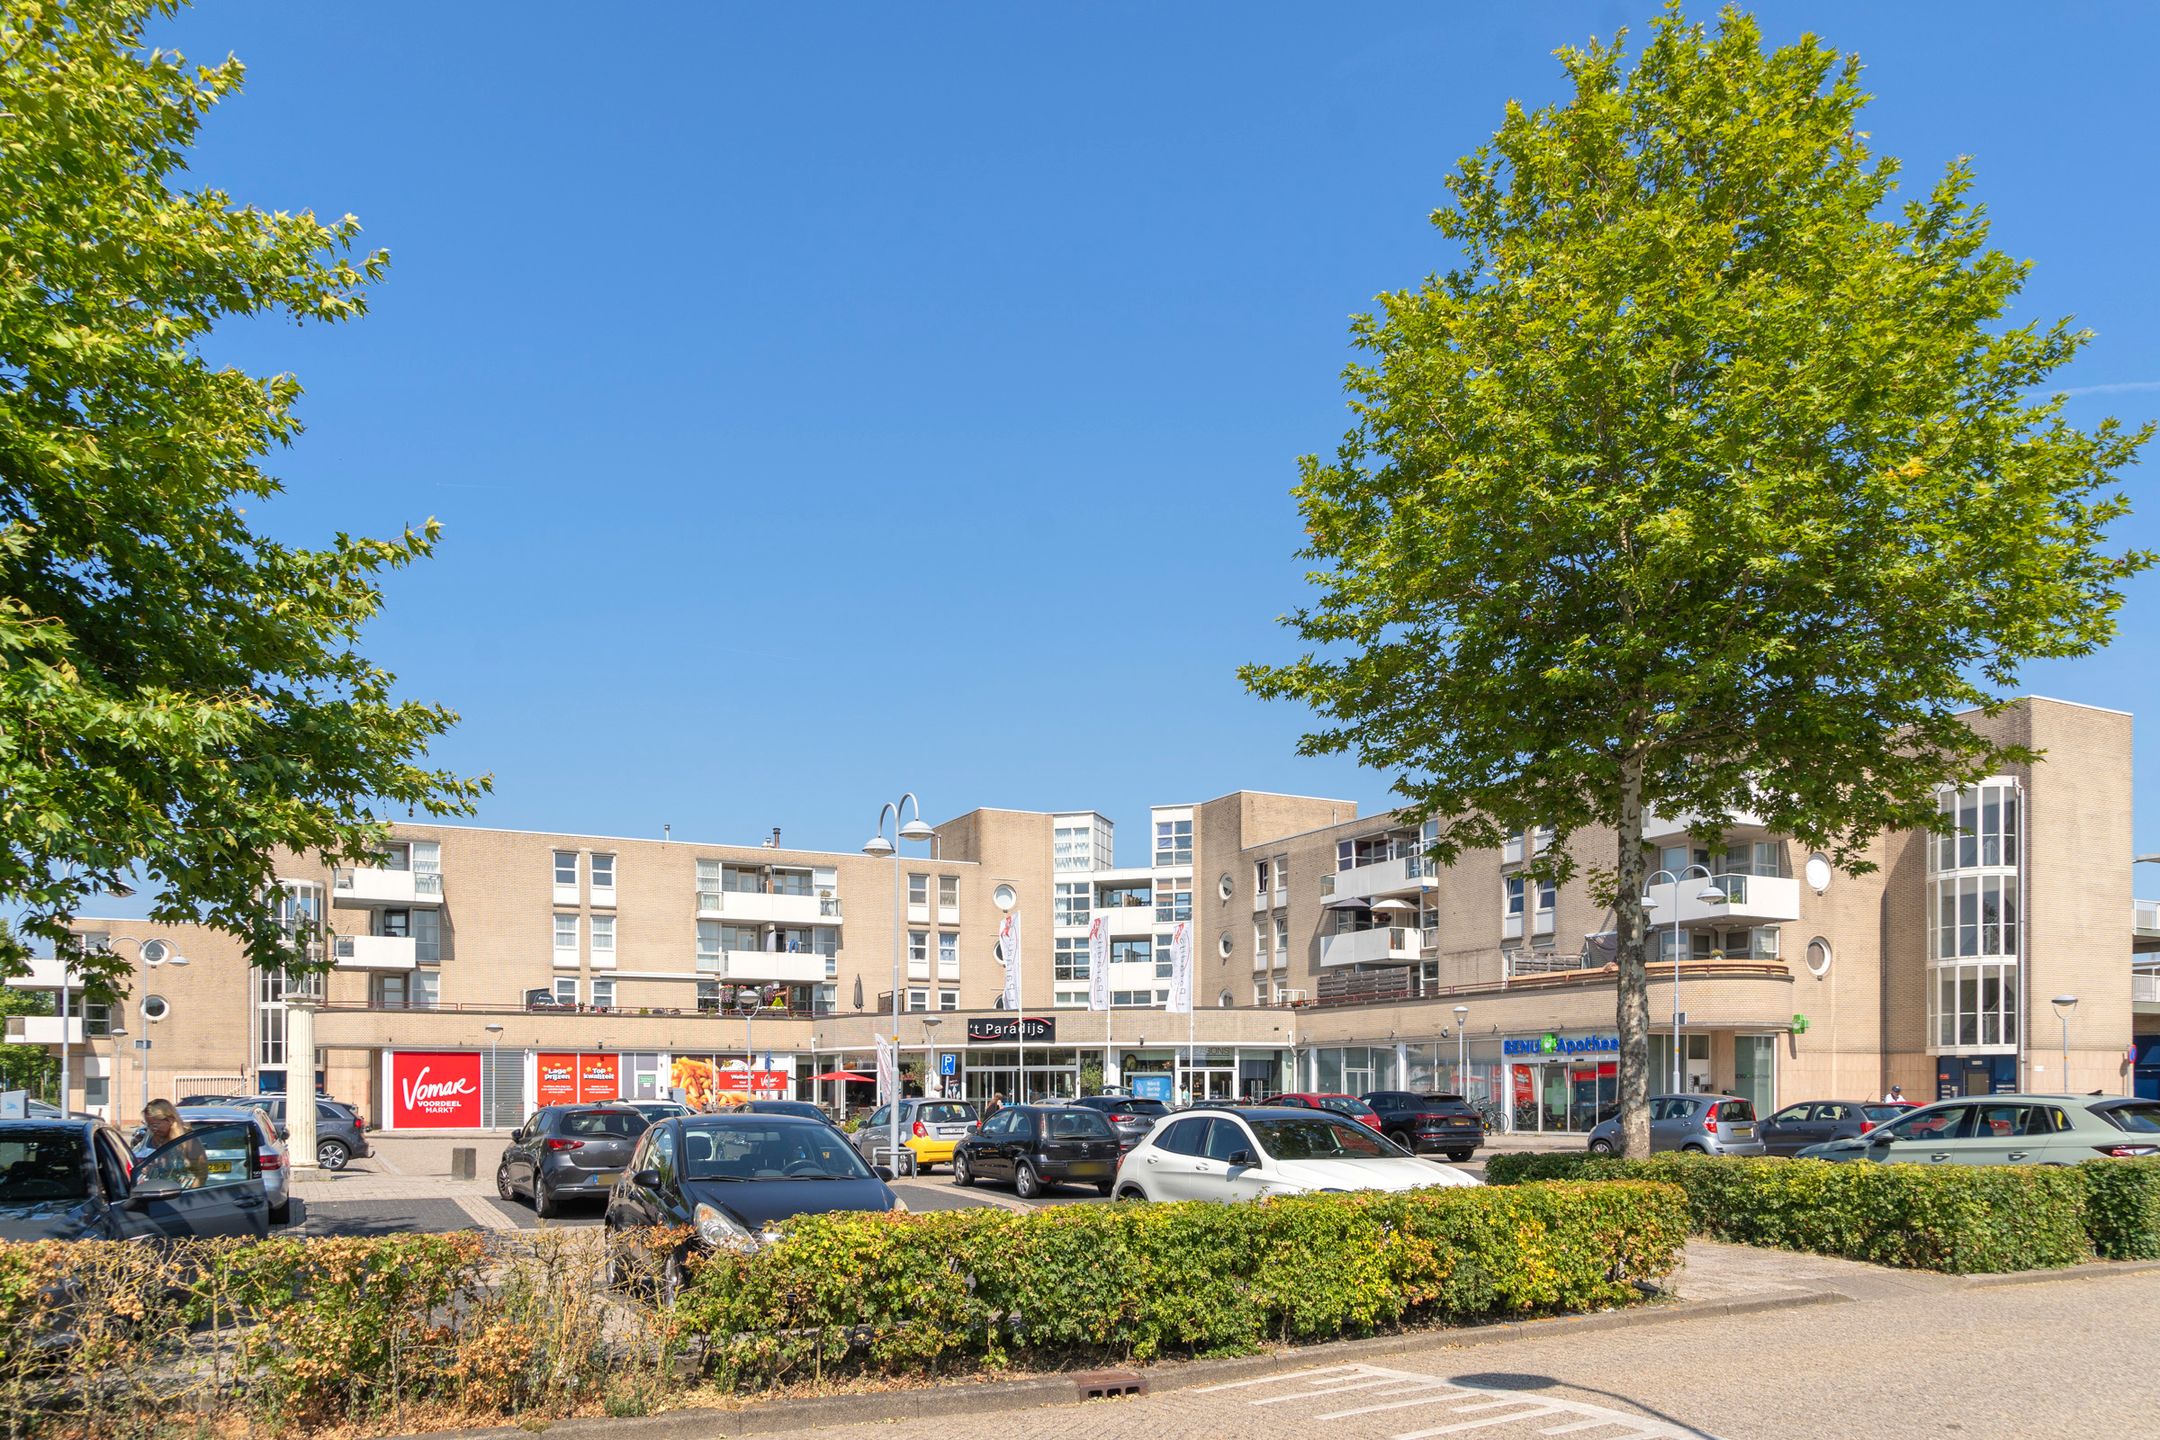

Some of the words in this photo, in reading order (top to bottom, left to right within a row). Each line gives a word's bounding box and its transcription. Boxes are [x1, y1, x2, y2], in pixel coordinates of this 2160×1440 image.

[985, 1023, 1045, 1036] Paradijs
[1504, 1040, 1540, 1055] BENU
[1557, 1035, 1620, 1056] Apothee
[944, 1056, 953, 1067] P
[548, 1067, 567, 1075] Lage
